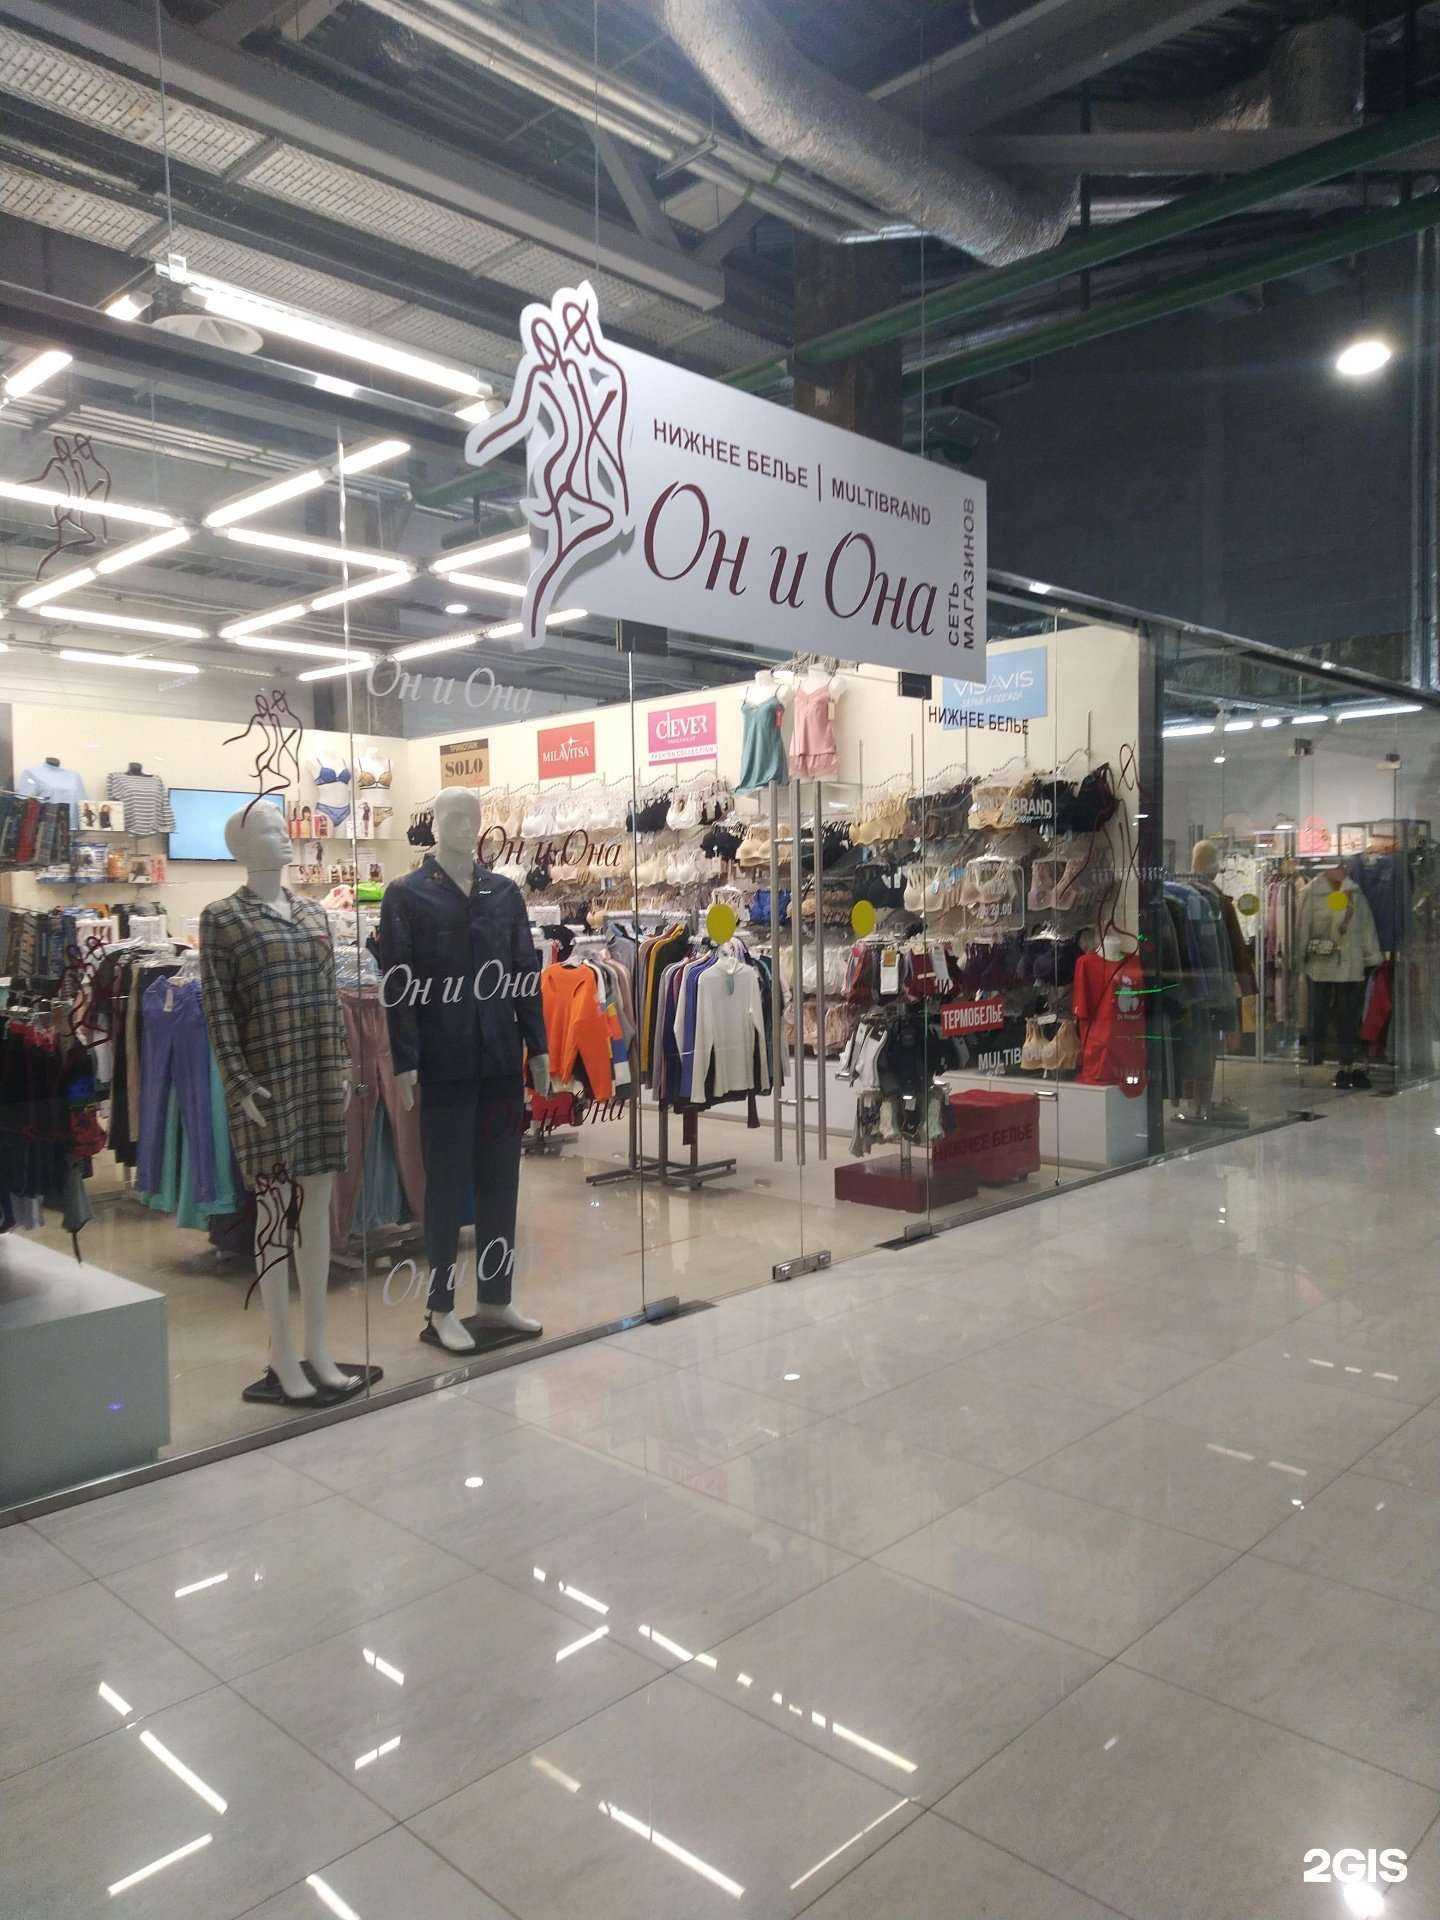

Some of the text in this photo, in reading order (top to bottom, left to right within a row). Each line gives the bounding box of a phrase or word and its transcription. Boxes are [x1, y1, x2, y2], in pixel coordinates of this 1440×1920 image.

[653, 419, 808, 489] НИЖНЕЕ БЕЛЬЕ
[832, 477, 931, 527] MULTIBRAND
[643, 480, 938, 637] Он и Она
[963, 498, 975, 650] МАГАЗИНОВ
[948, 582, 960, 646] СЕТЬ
[367, 655, 533, 713] Он и Она
[928, 706, 1029, 735] НИЖНЕЕ БЕЛЬЕ
[445, 757, 483, 778] SOLO
[476, 825, 622, 867] Он и Она
[379, 959, 541, 1008] Он и Она
[942, 1003, 1004, 1030] ТЕРМОБЕЛЬЕ
